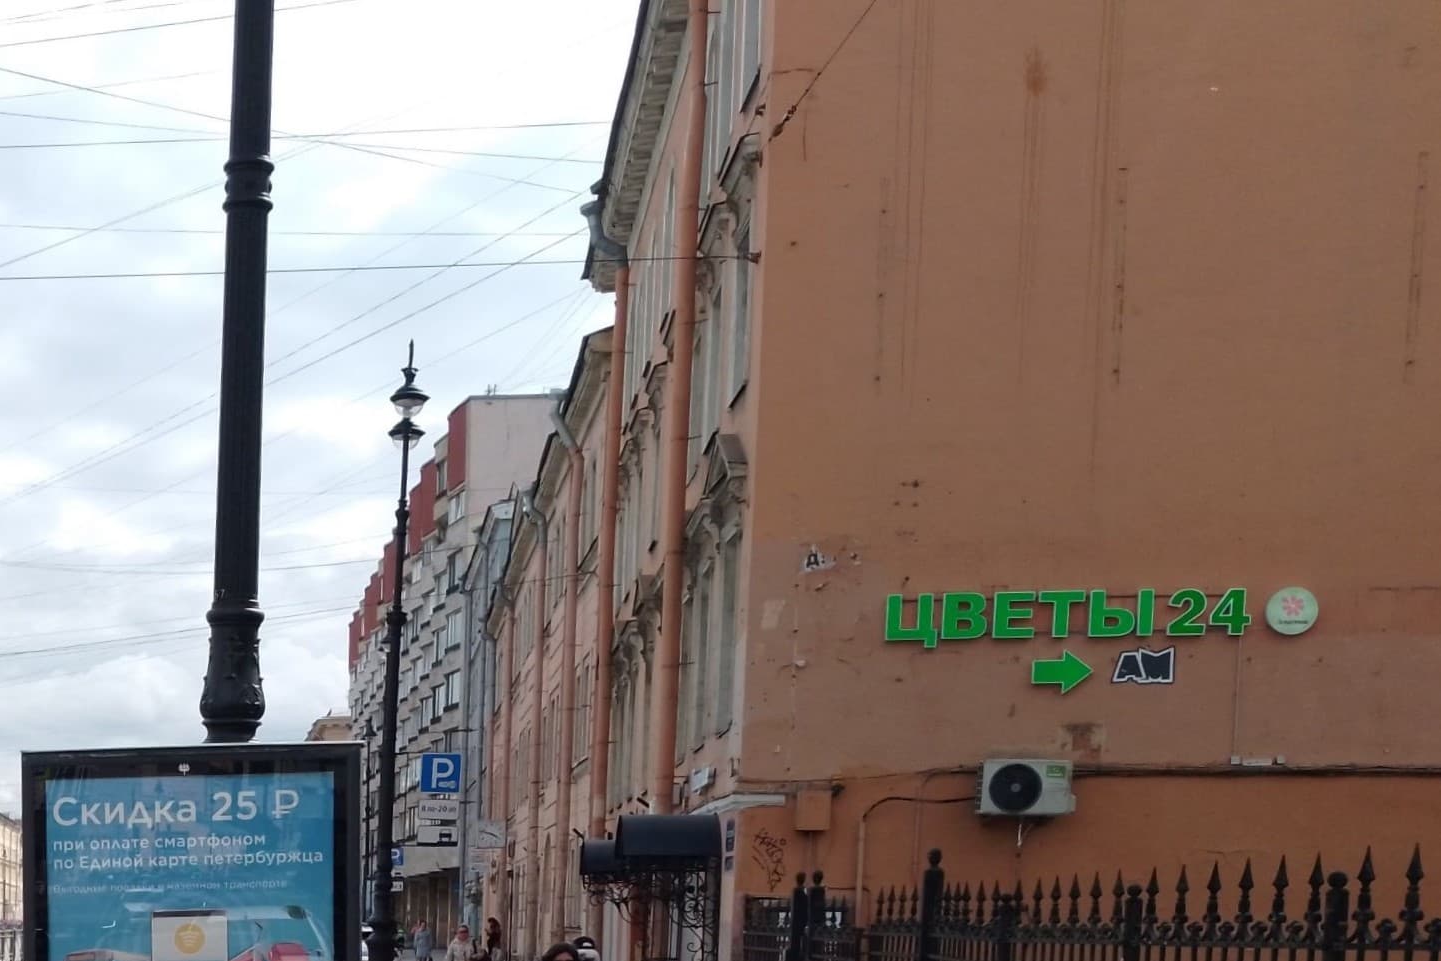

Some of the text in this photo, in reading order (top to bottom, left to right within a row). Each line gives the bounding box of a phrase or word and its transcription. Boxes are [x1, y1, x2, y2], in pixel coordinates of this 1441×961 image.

[885, 588, 1252, 648] ЦВЕТЫ 24
[52, 796, 198, 830] Скидка
[211, 789, 258, 821] 25
[53, 832, 266, 853] при оплате смартфоном
[53, 850, 324, 872] по Единой карте петербуржца
